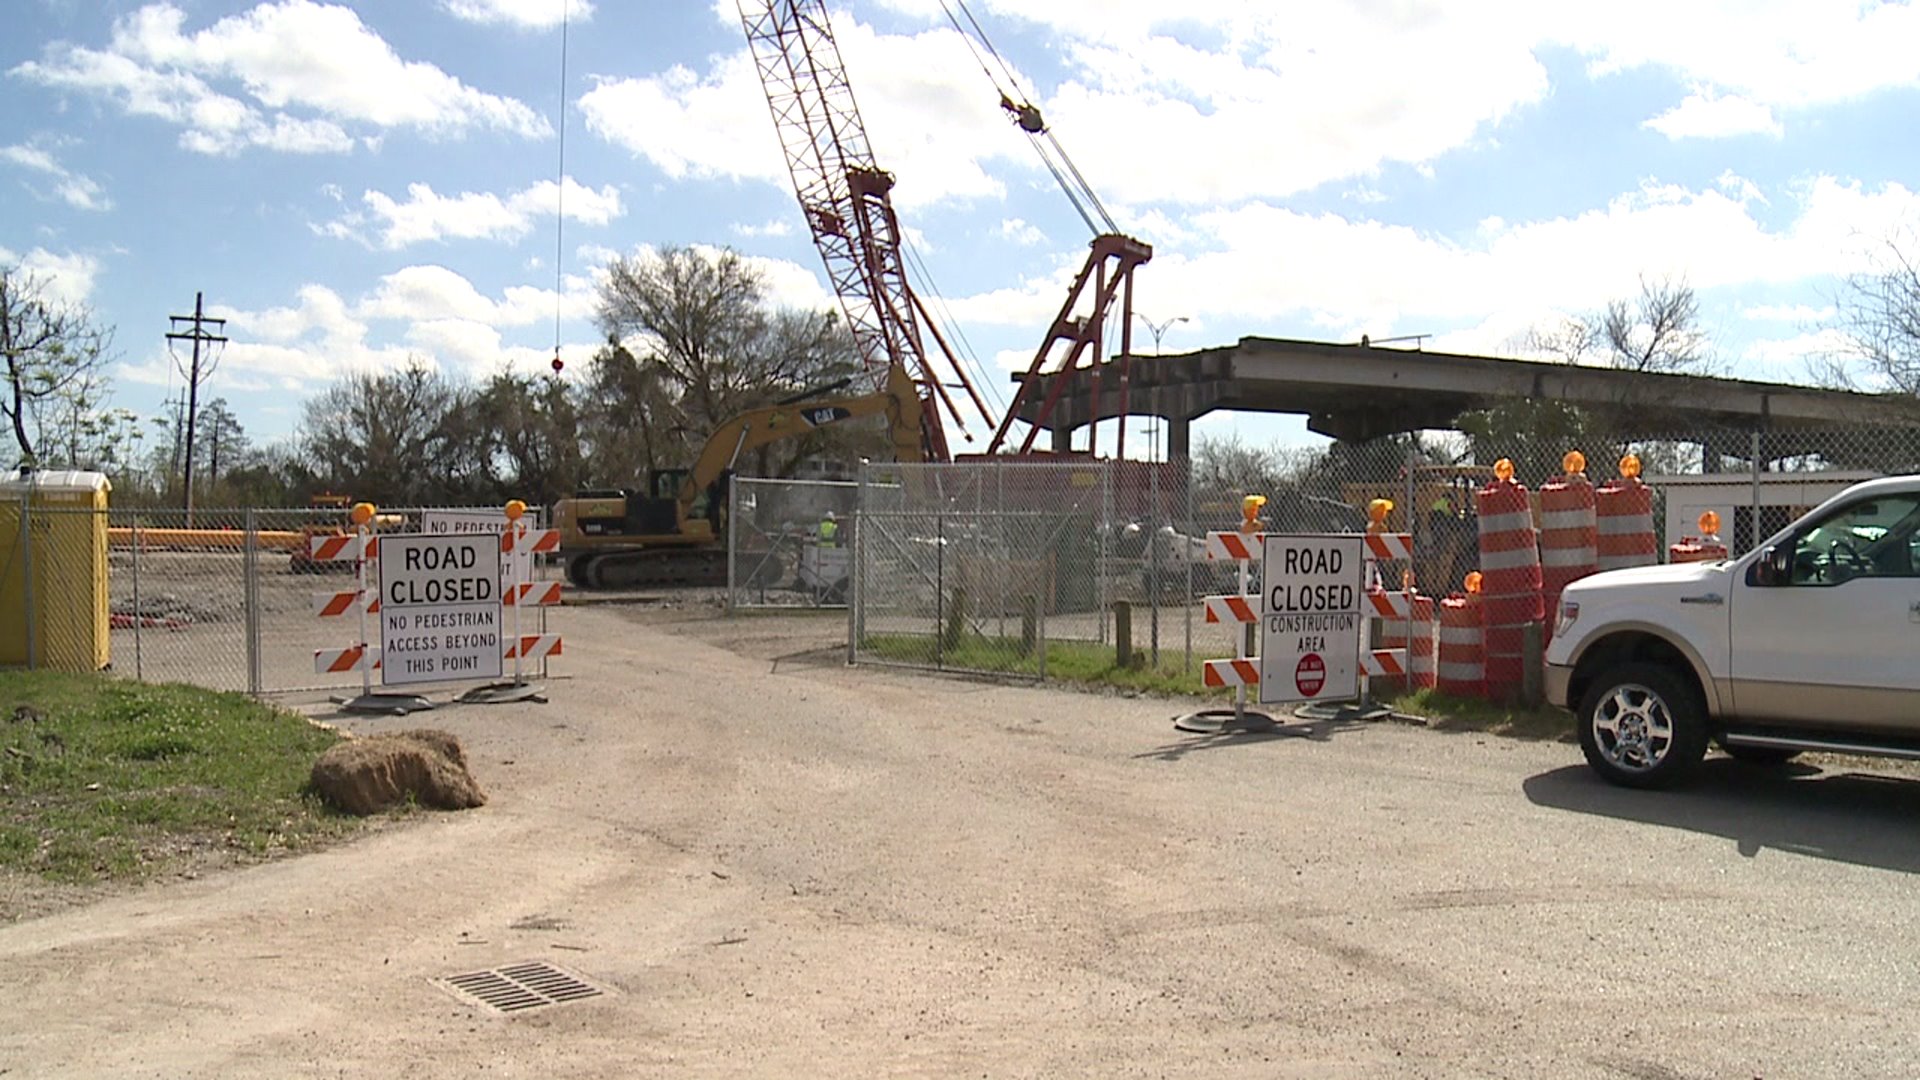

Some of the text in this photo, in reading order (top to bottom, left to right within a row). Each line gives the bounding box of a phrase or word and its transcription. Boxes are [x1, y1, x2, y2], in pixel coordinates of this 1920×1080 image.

[814, 408, 834, 424] CAT
[431, 521, 448, 533] NO
[405, 546, 476, 571] ROAD
[1285, 548, 1342, 574] ROAD
[390, 578, 492, 605] CLOSED
[1271, 585, 1352, 612] CLOSED
[389, 611, 493, 631] NO PEDESTRIAN
[1271, 615, 1353, 633] CONSTRUCTION
[388, 633, 496, 654] ACCESS BEYOND
[1297, 637, 1326, 653] AREA
[406, 656, 479, 673] THIS POINT
